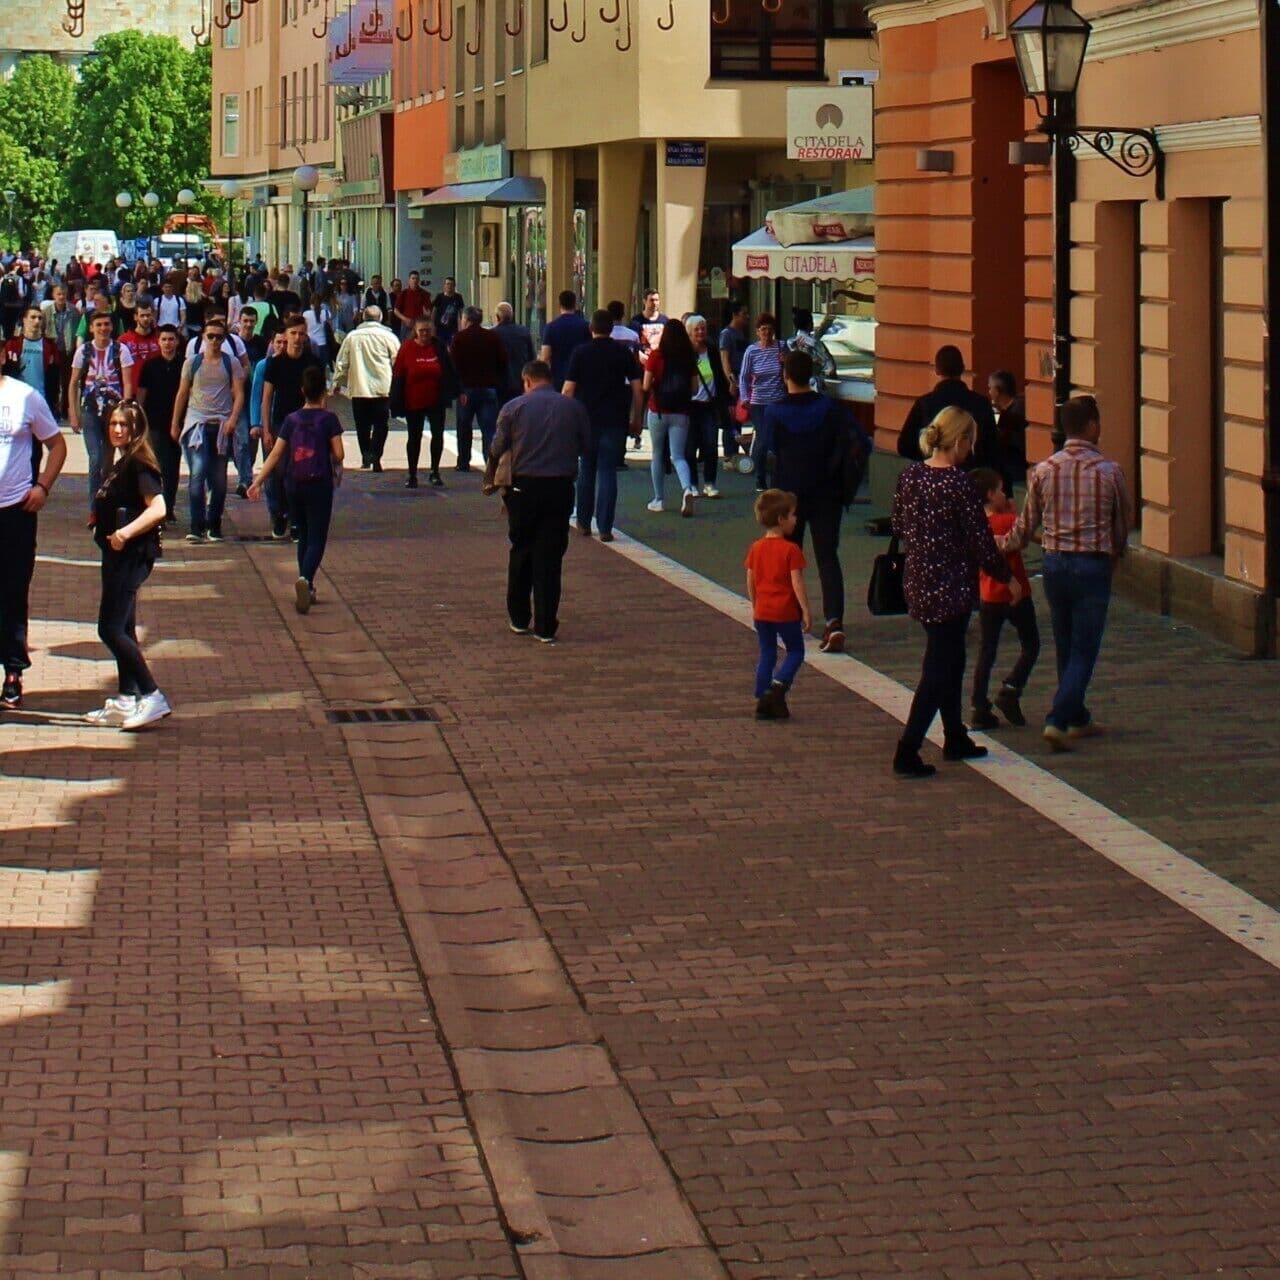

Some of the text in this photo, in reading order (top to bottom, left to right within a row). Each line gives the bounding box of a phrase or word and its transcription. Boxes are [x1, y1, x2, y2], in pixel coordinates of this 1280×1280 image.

[793, 135, 865, 148] CITADELA
[798, 147, 862, 158] RESTORAN
[783, 255, 838, 273] CITADELA
